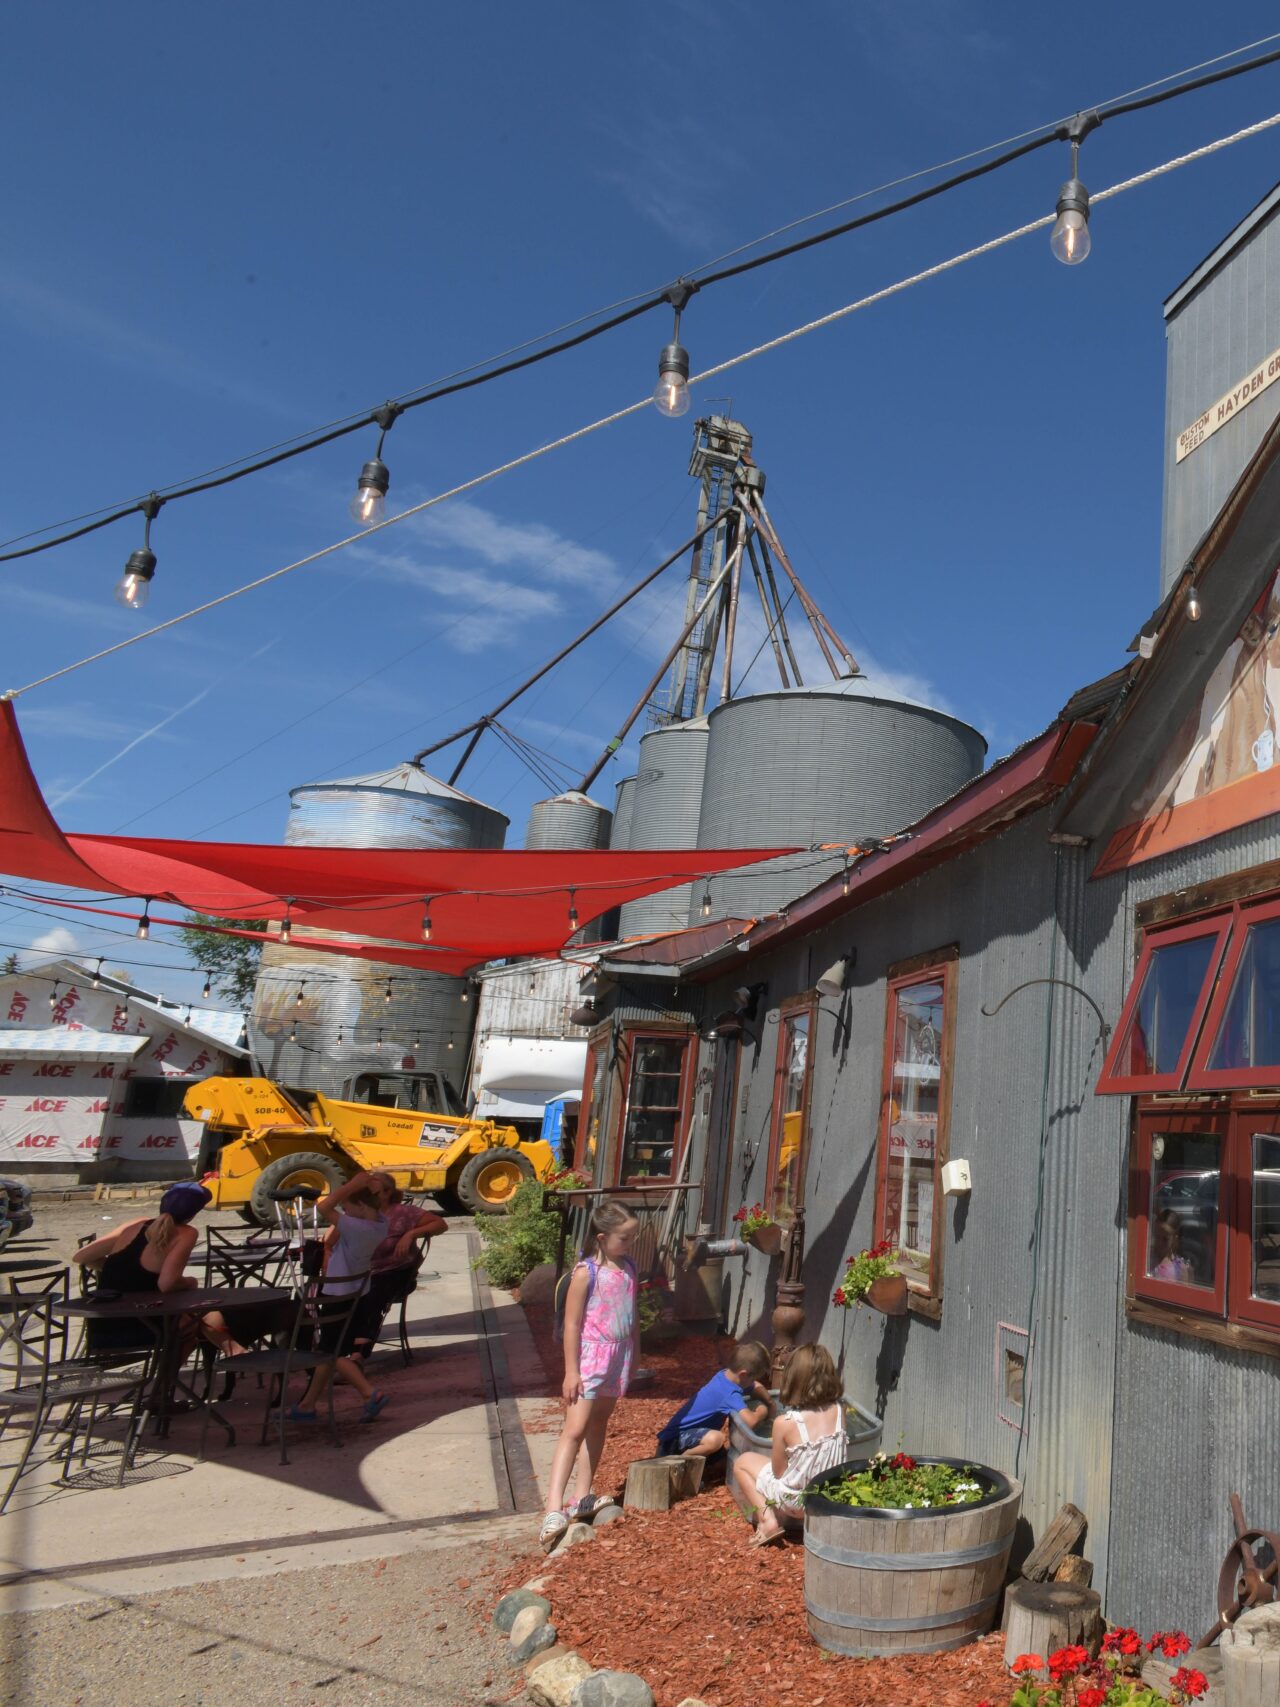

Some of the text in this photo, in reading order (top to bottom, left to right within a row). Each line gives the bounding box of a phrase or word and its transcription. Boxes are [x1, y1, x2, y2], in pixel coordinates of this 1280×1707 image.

[1217, 370, 1263, 422] HAYDEN
[1184, 430, 1205, 454] FEED
[32, 1062, 76, 1077] ACE
[24, 1098, 68, 1112] ACE
[387, 1121, 414, 1130] Loadall
[16, 1133, 60, 1147] ACE
[139, 1134, 178, 1148] ACE
